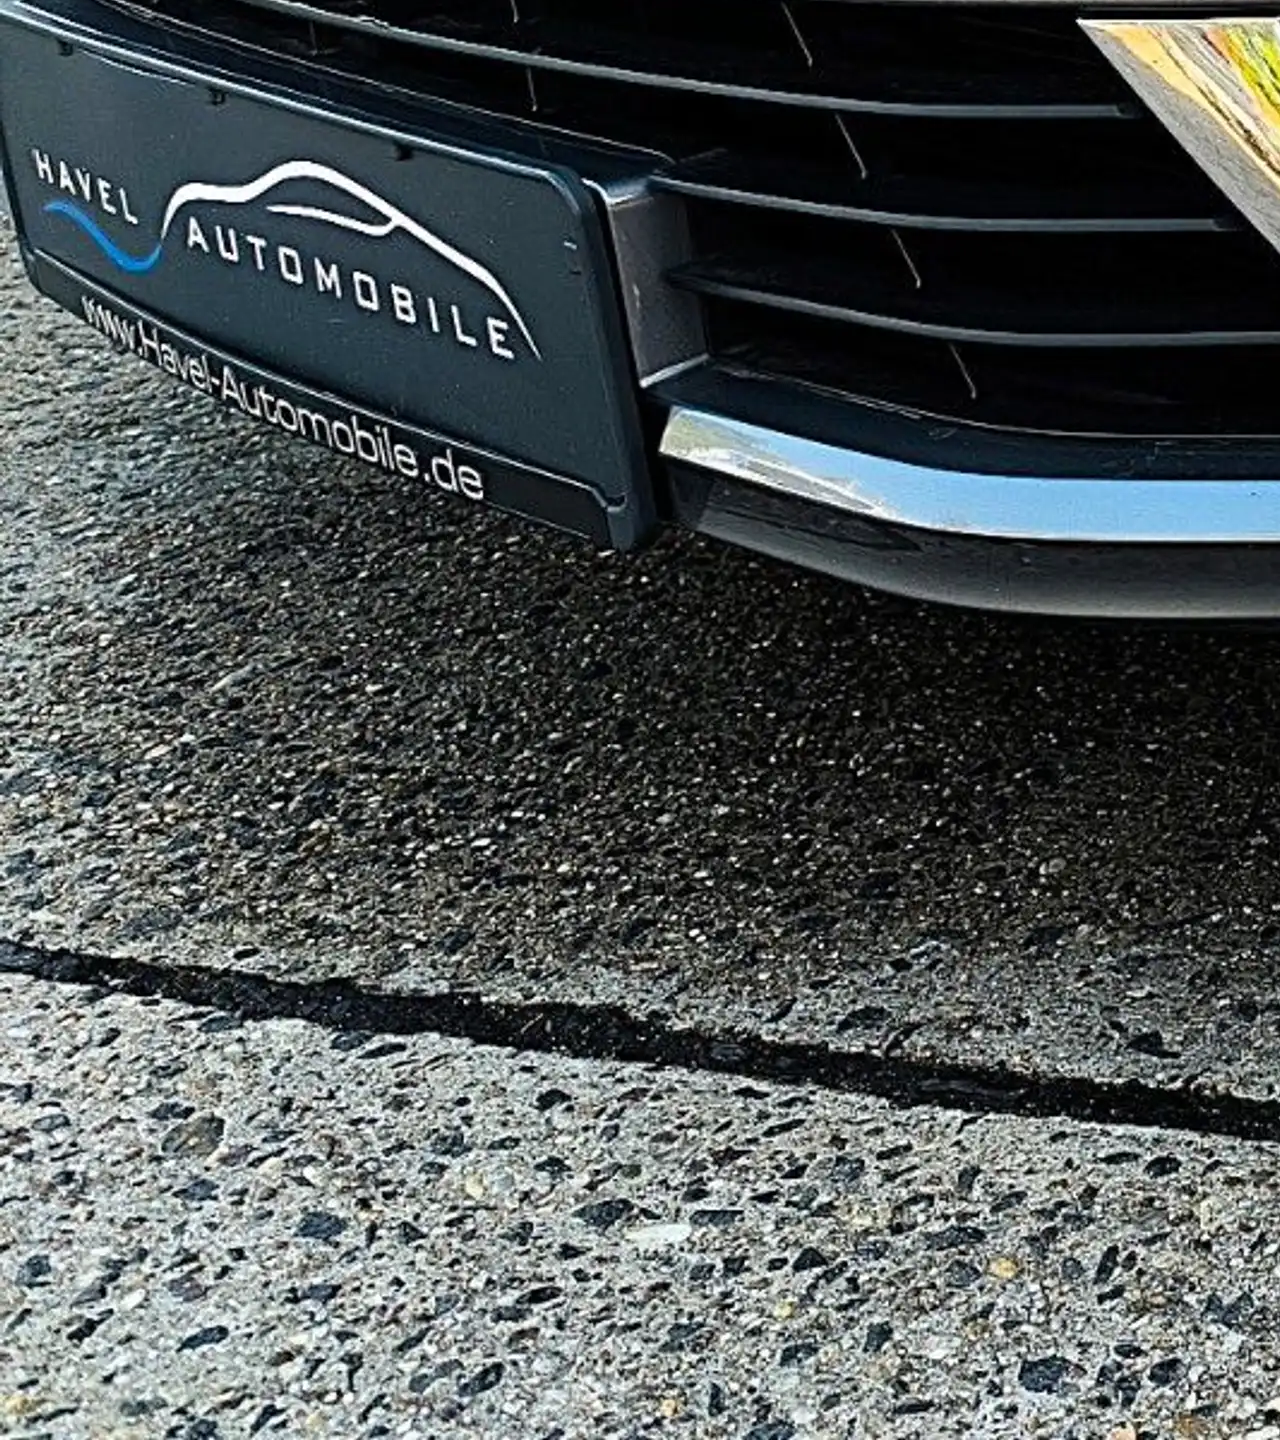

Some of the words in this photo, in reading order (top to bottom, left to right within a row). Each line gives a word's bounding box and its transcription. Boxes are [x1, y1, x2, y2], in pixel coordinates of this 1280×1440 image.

[33, 148, 138, 224] HAVEL
[187, 217, 515, 359] AUTOMOBILE
[81, 296, 485, 501] www.Havel-Automobile.de
